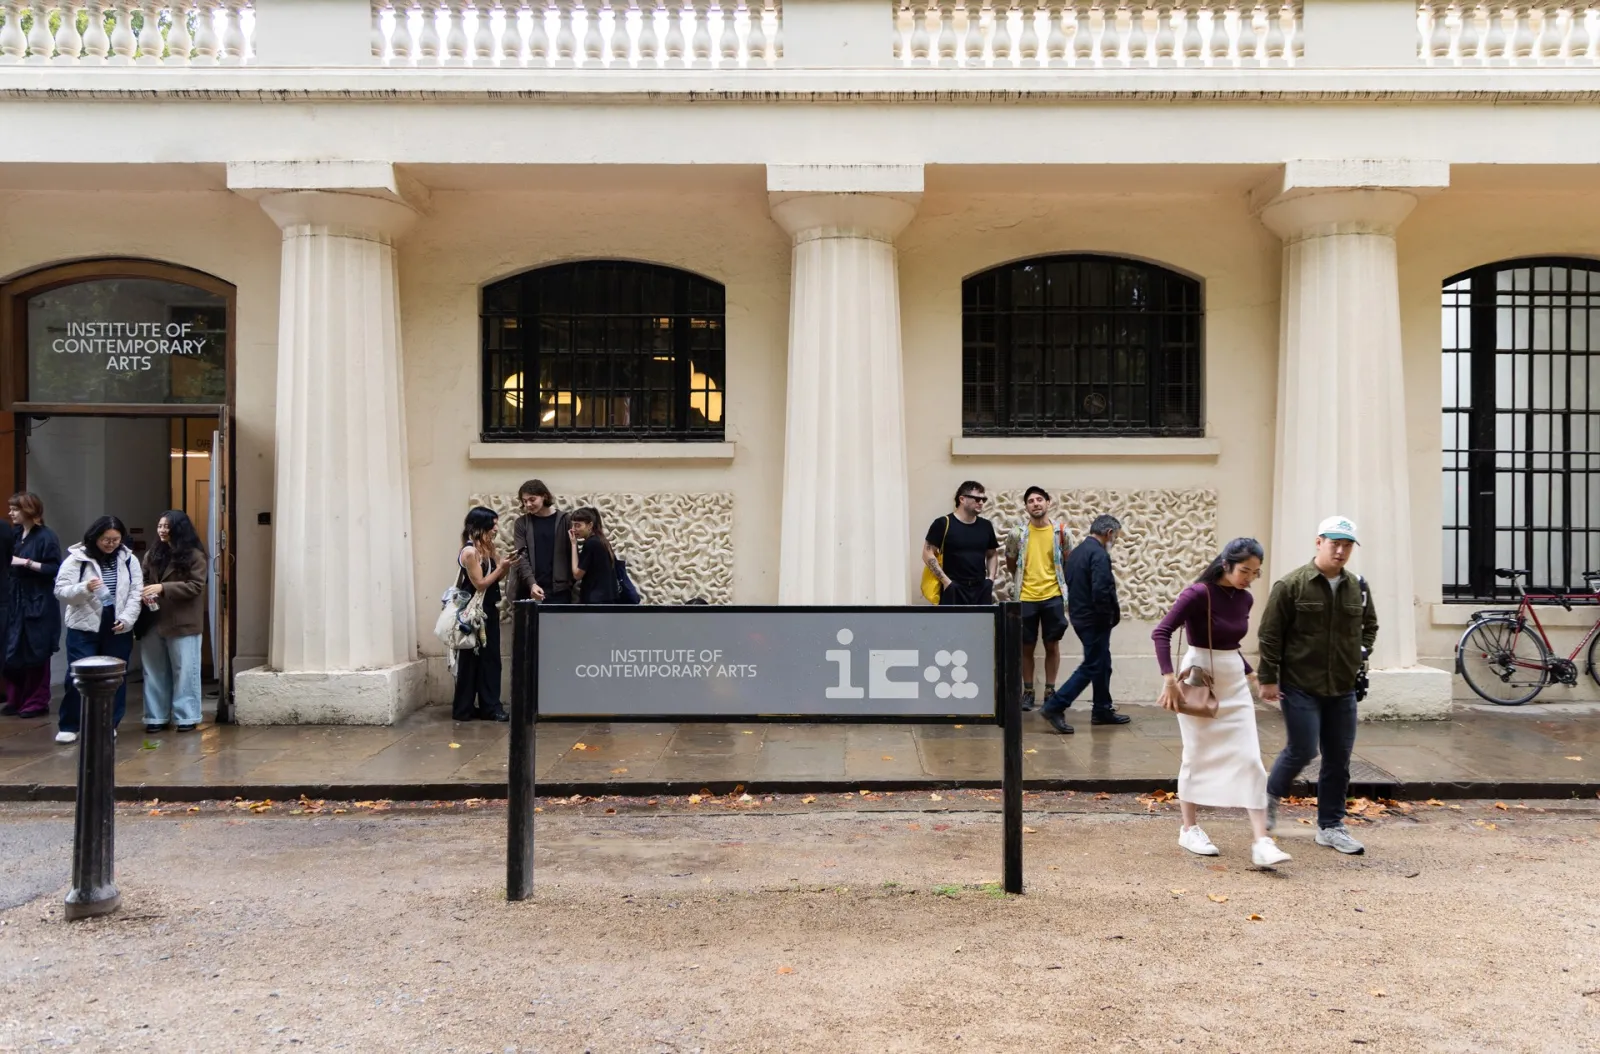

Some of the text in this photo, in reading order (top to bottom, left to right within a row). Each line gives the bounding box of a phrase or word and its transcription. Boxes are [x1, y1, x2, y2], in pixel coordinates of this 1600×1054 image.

[67, 322, 192, 337] INSTITUTE OF
[52, 338, 206, 354] CONTEMPORARY
[106, 356, 152, 371] ARTS
[610, 649, 723, 663] INSTITUTE OF
[575, 664, 758, 678] CONTEMPORARY ARTS
